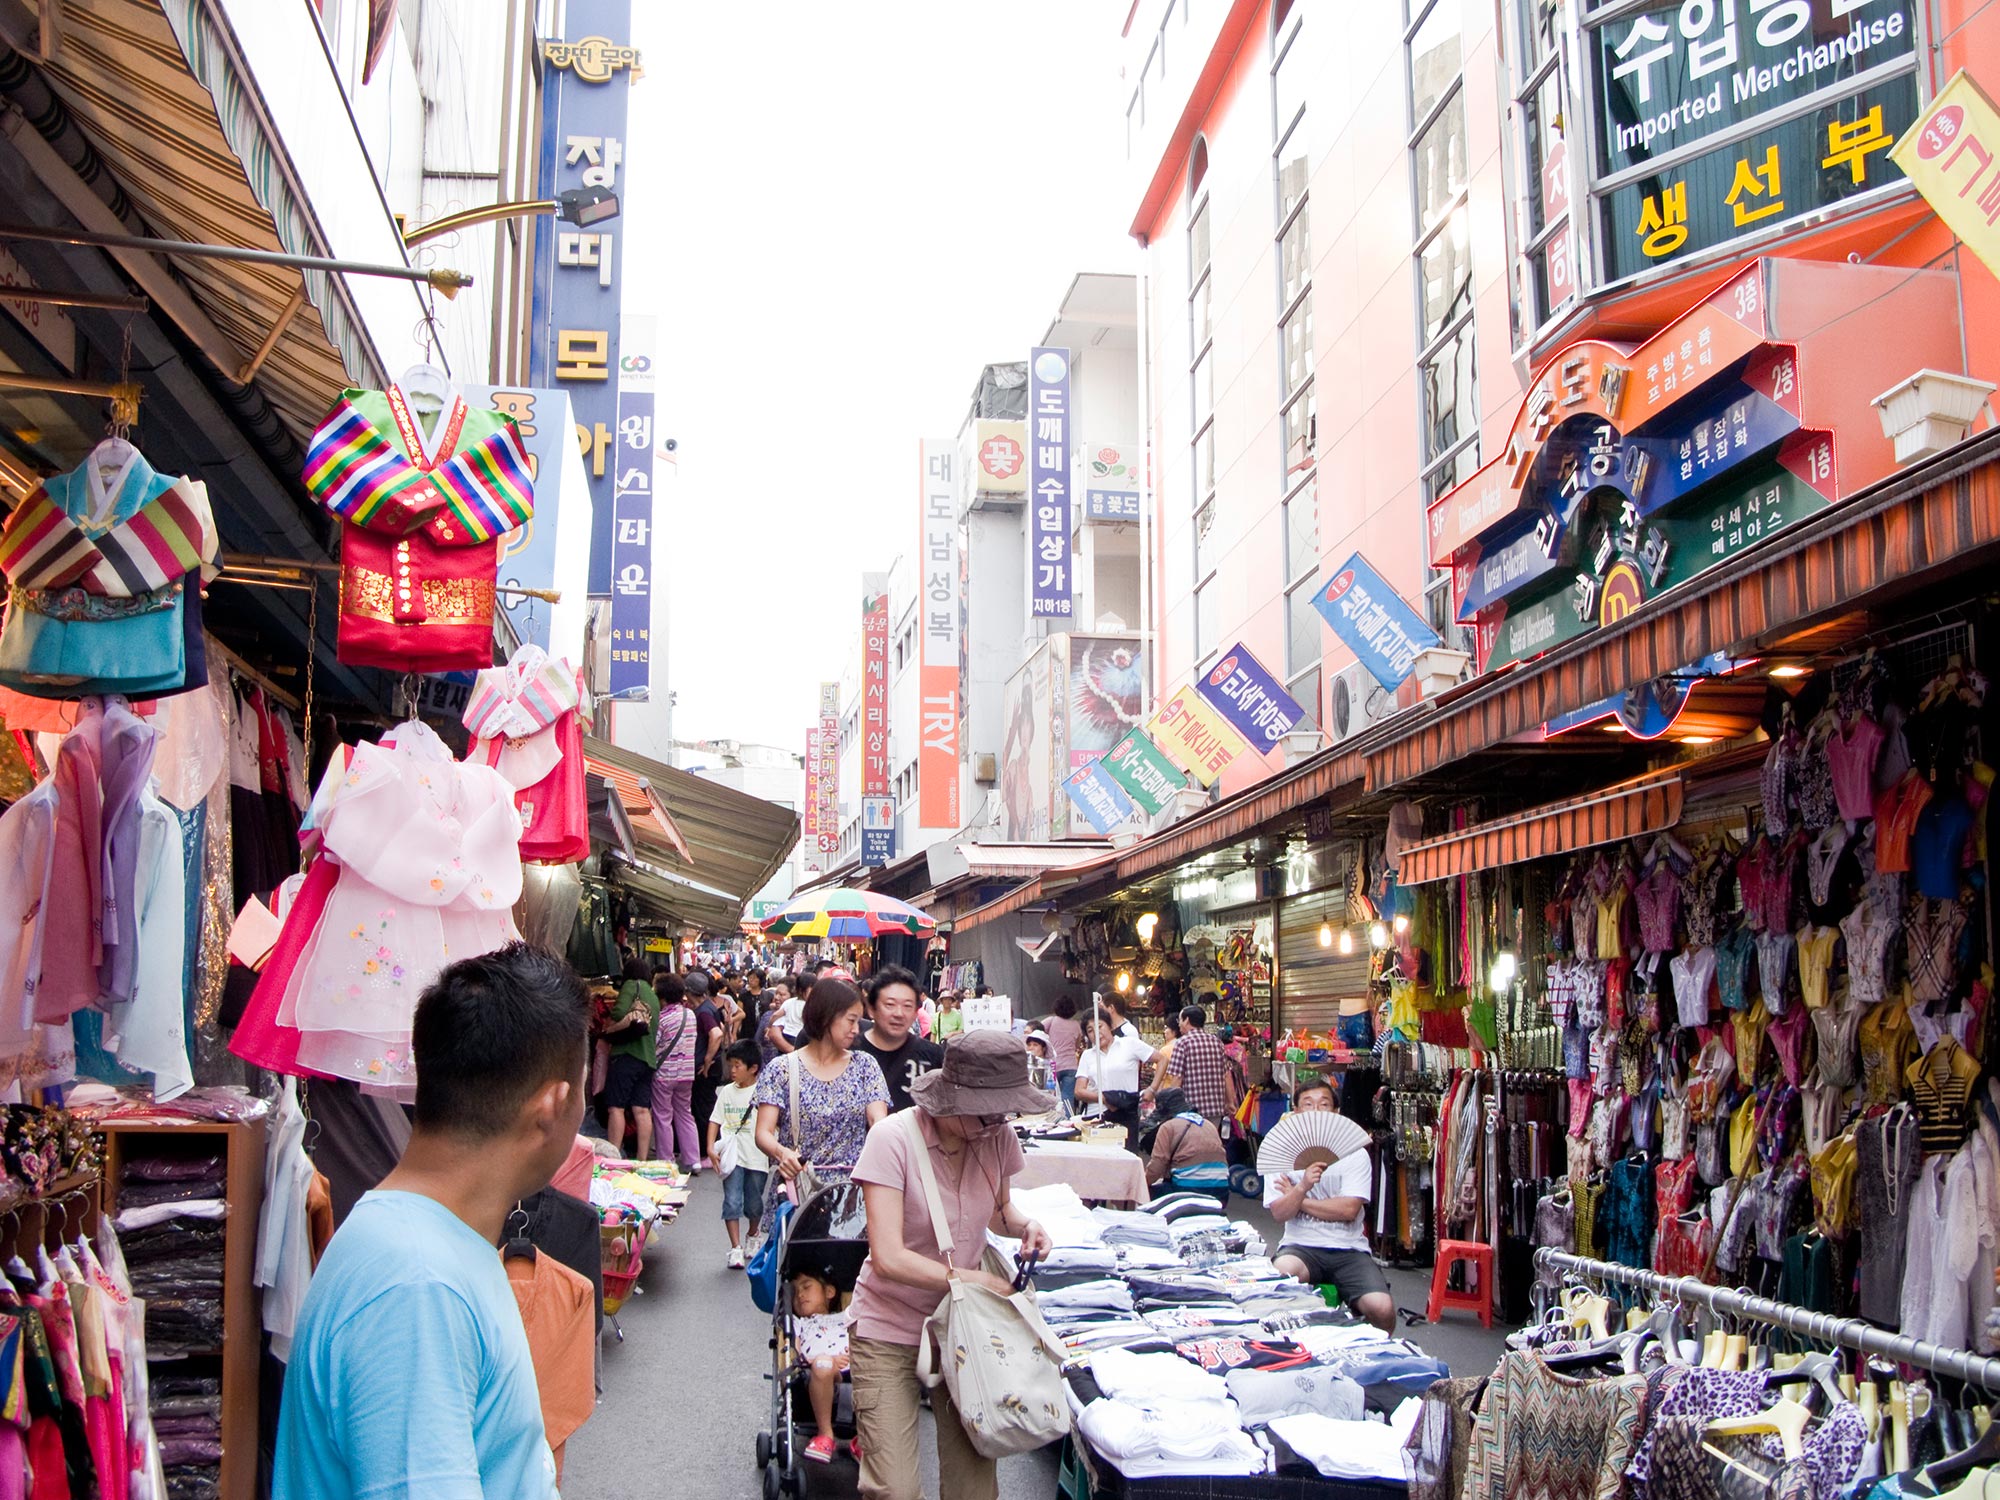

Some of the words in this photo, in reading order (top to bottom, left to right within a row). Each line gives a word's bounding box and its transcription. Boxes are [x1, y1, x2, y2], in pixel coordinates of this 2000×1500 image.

[1616, 83, 1721, 153] Imported
[1733, 13, 1903, 104] Merchandise
[1925, 114, 1955, 151] 3층
[1734, 277, 1757, 320] 3층
[1646, 326, 1712, 382] 주방용품
[1647, 349, 1712, 405] 프라스틱
[1771, 358, 1793, 401] 2층
[1680, 405, 1746, 460] 생활장식
[985, 441, 1018, 473] 꽃
[1807, 442, 1831, 484] 1층
[1037, 389, 1065, 591] 도깨비수입상가
[1711, 485, 1781, 532] 악세사리
[1432, 507, 1444, 537] 3F
[1712, 512, 1782, 554] 메리야스
[1331, 576, 1349, 596] 1층
[1457, 564, 1470, 593] 2F
[1034, 599, 1071, 614] 지하1층
[612, 628, 648, 641] 숙녀복
[1480, 623, 1494, 651] 1F
[868, 635, 885, 777] 악세사리상가
[923, 691, 955, 756] TRY
[1222, 668, 1291, 741] 민속공예
[1169, 710, 1232, 771] 그릇도매
